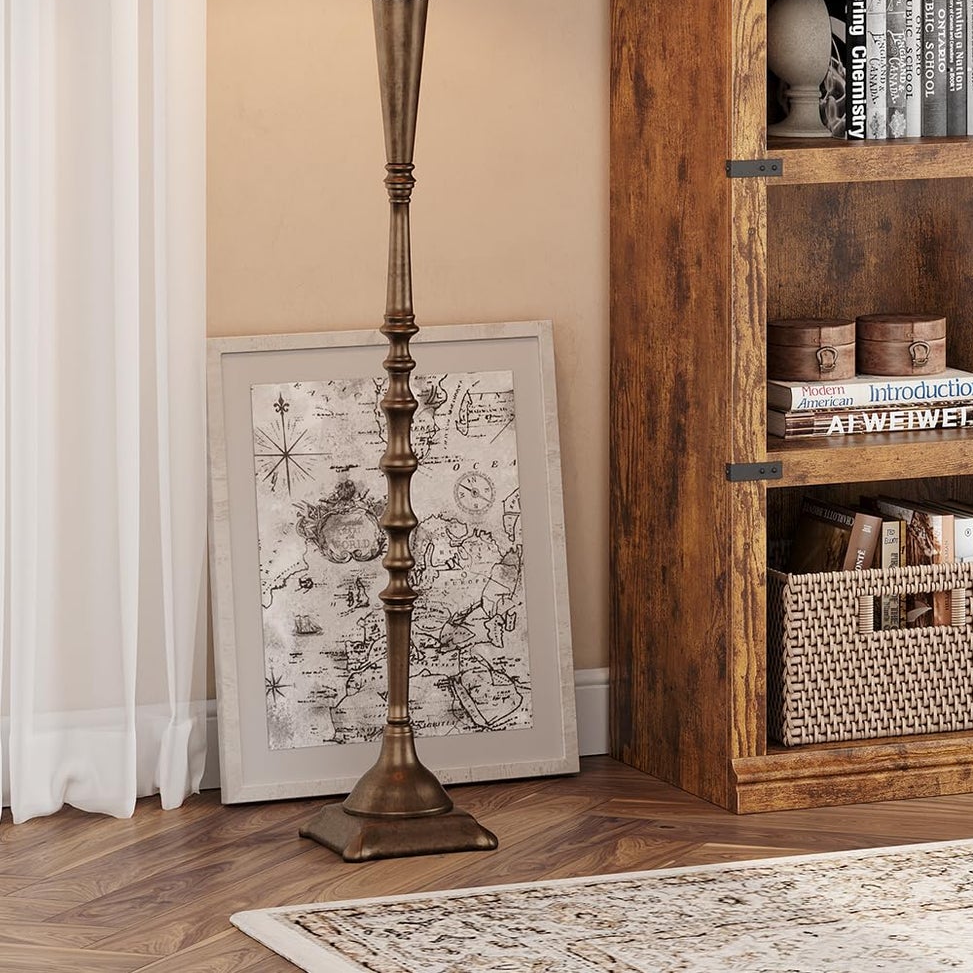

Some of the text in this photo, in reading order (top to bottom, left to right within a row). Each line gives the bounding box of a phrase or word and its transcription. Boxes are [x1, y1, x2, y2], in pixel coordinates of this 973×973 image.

[868, 30, 886, 85] ENGLAND
[938, 9, 946, 73] ONTARIO
[955, 41, 963, 49] a
[848, 45, 866, 139] Chemistry
[905, 46, 914, 101] SCHOOL
[924, 41, 935, 98] SCHOOL
[954, 51, 964, 91] Nation
[797, 396, 854, 409] American
[801, 385, 846, 397] Modern
[826, 415, 856, 436] AI
